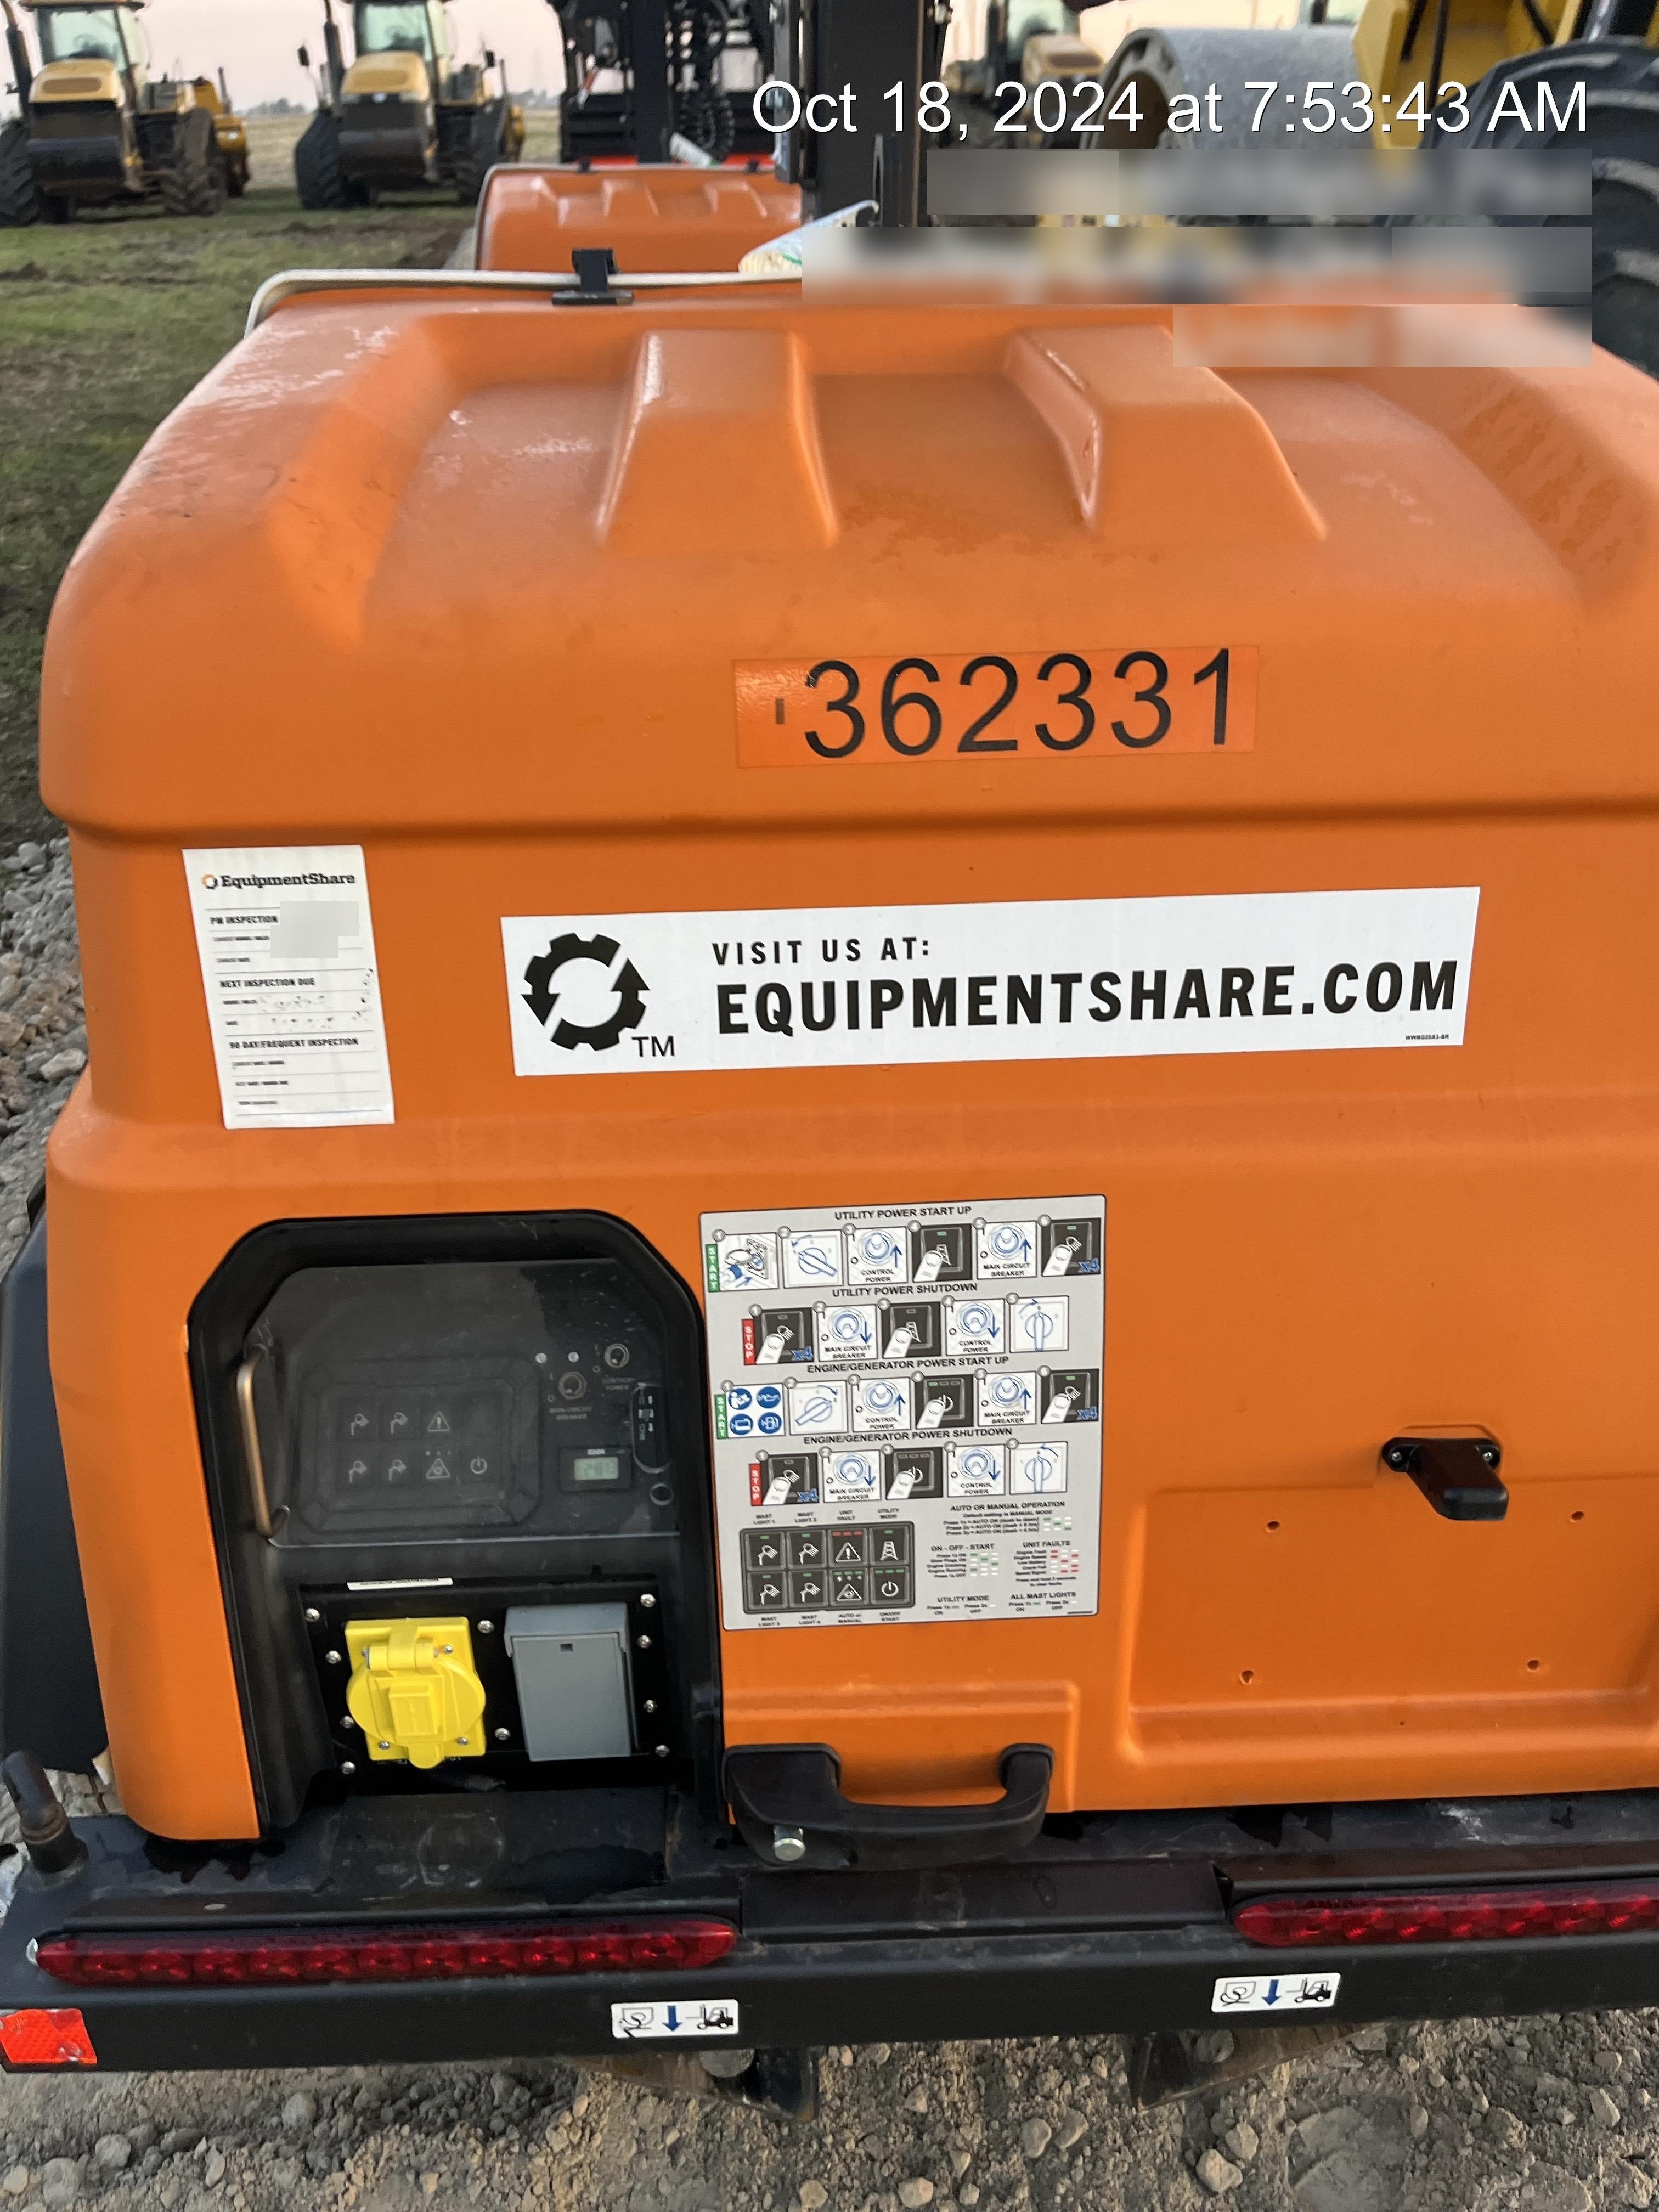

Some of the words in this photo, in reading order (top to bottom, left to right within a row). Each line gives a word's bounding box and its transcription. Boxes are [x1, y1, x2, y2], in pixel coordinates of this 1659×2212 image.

[804, 648, 1229, 759] 362331
[220, 873, 356, 889] EquipmentShare
[712, 940, 802, 966] VISIT
[822, 939, 861, 962] US
[881, 936, 932, 960] AT:
[244, 978, 295, 987] INSPECTION
[717, 960, 1458, 1034] EQUIPMENTSHARE.COM
[307, 1037, 359, 1046] INSPECTION
[633, 1036, 675, 1057] TM
[834, 1210, 874, 1220] UTILITY
[878, 1208, 917, 1218] POWER
[920, 1206, 954, 1216] START
[957, 1206, 972, 1215] UP
[833, 1288, 872, 1297] UTILITY
[874, 1286, 913, 1295] POWER
[917, 1283, 977, 1294] SHUTDOWN
[744, 1325, 754, 1358] STOP
[807, 1360, 915, 1373] ENGINE/GENERATOR
[917, 1358, 956, 1368] POWER
[958, 1357, 992, 1367] START
[995, 1356, 1009, 1364] UP
[716, 1397, 725, 1436] START
[804, 1432, 910, 1445] ENGINE/GENERATOR
[912, 1430, 950, 1439] POWER
[953, 1428, 1012, 1437] SHUTDOWN
[752, 1470, 760, 1500] STOP
